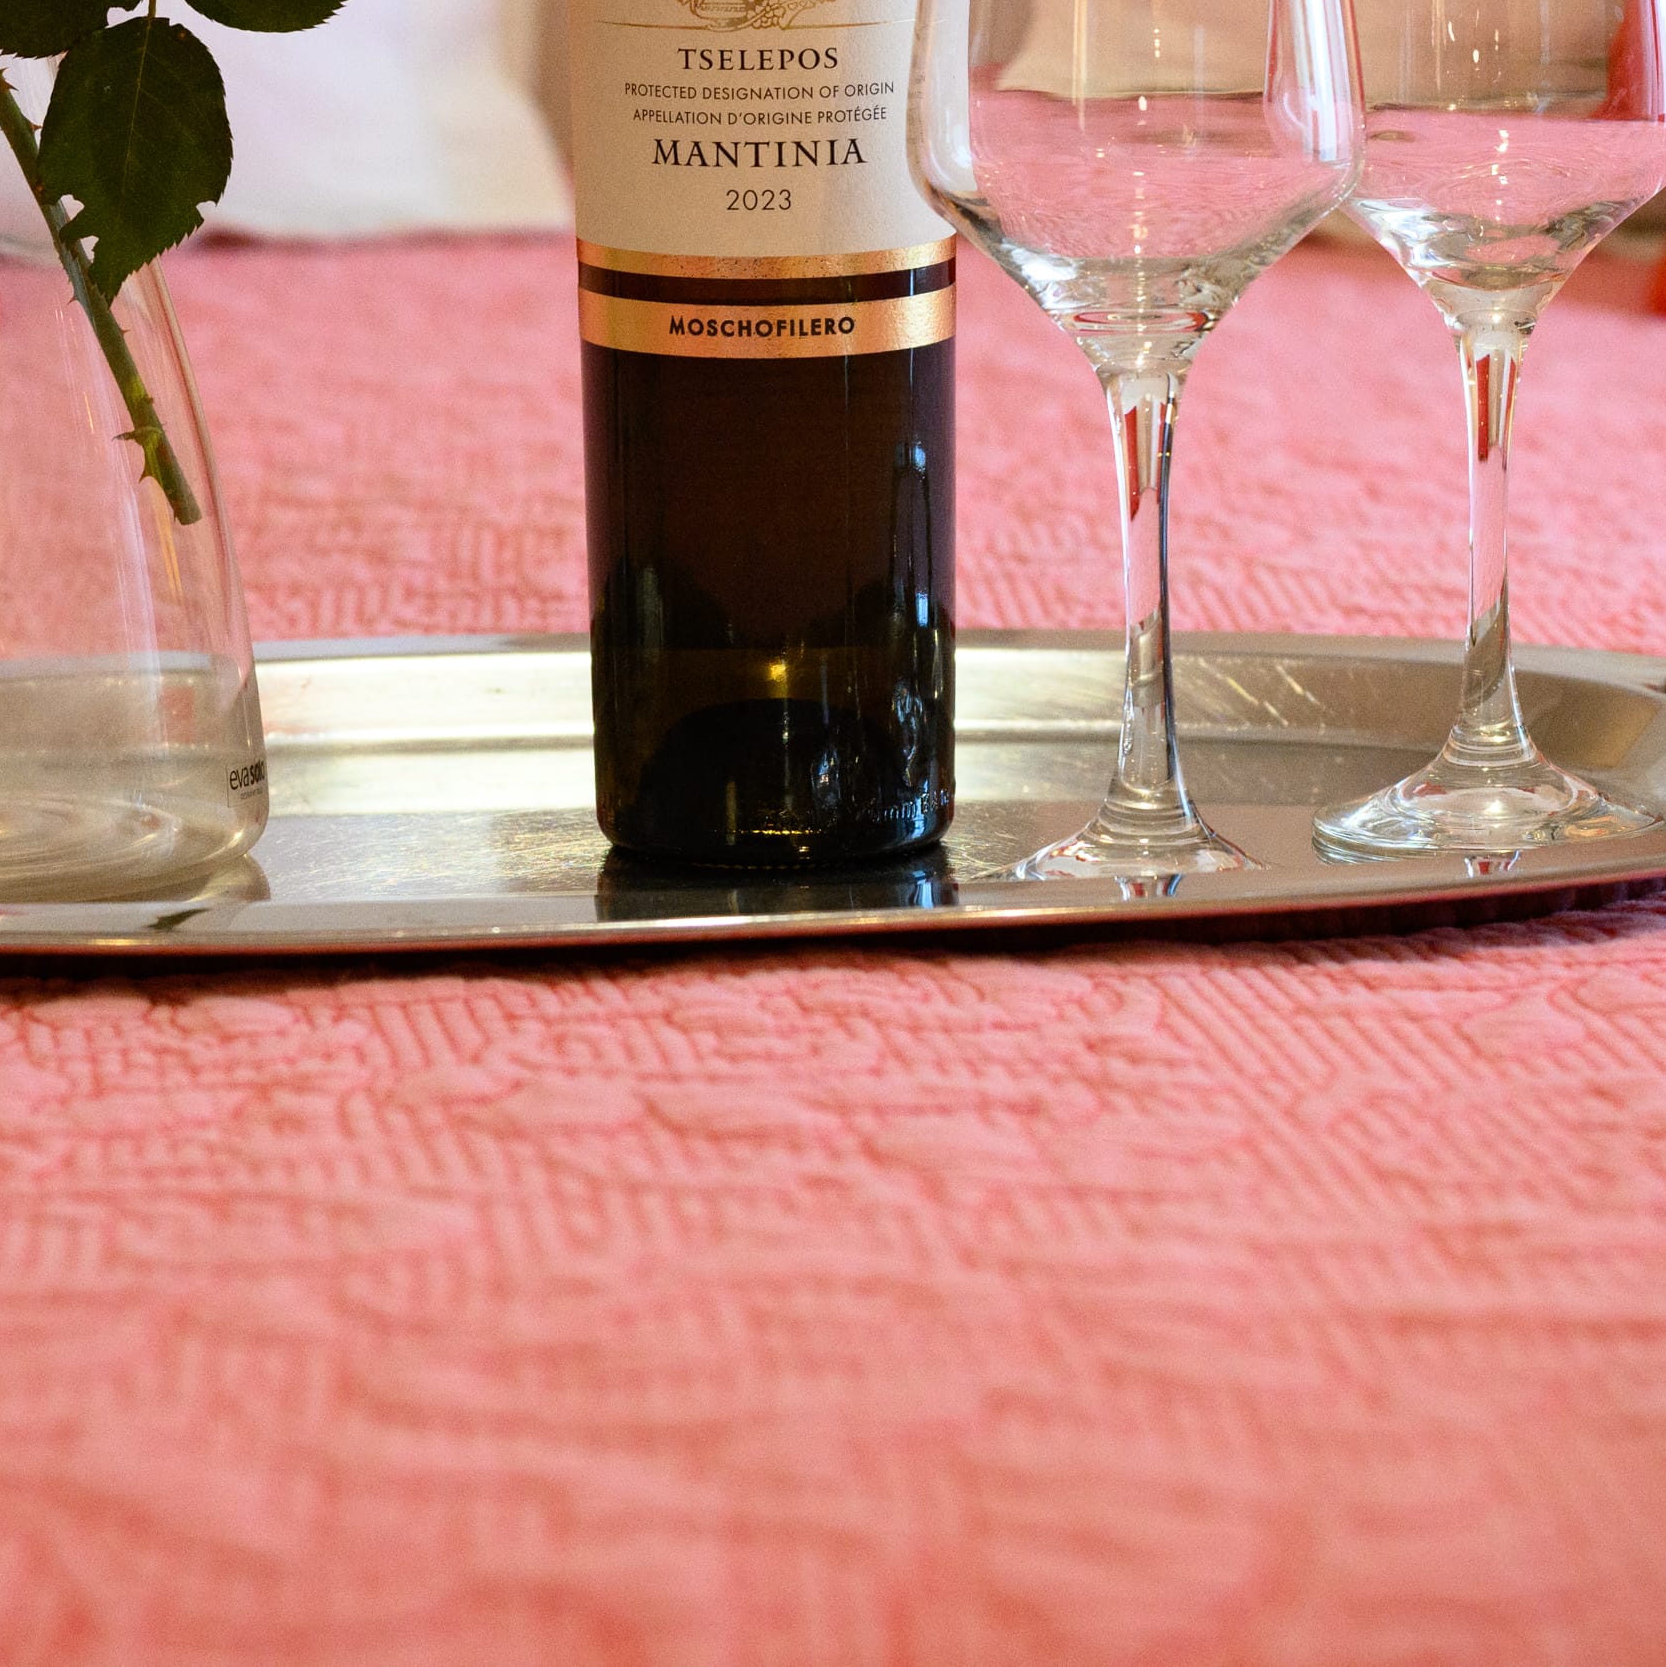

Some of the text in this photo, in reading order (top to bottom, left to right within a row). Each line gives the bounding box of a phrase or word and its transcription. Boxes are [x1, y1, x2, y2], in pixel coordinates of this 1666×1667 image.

[677, 47, 838, 71] TSELEPOS
[624, 81, 894, 101] PROTECTED DESIGNATION OF ORIGIN
[632, 104, 887, 126] APPELLATION D'ORIGINE PROTÉGÉE
[651, 138, 868, 168] MANTINIA
[726, 189, 792, 211] 2023
[669, 315, 855, 338] MOSCHOFILERO
